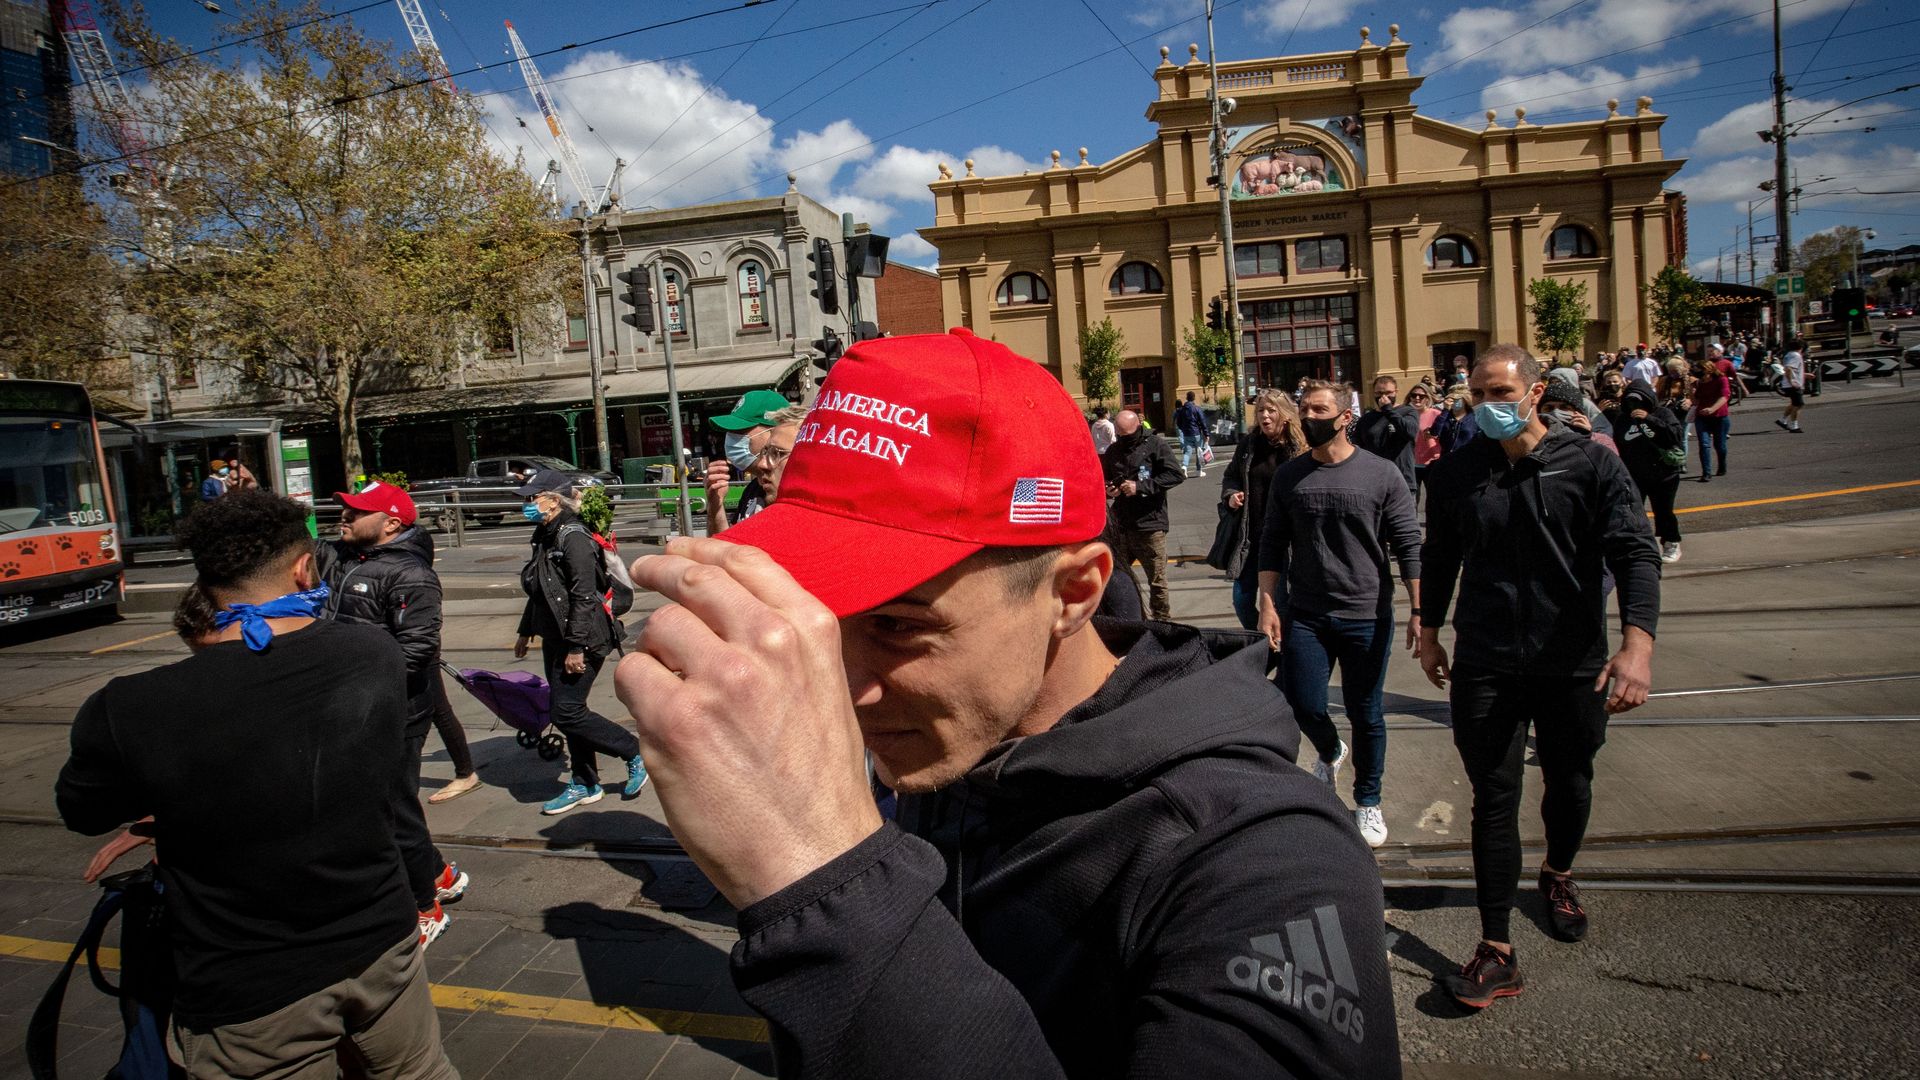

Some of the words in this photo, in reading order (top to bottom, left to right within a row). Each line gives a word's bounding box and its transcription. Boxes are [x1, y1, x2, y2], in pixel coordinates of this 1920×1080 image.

[1233, 220, 1260, 229] QUEEN
[1265, 215, 1308, 226] VICTORIA
[1312, 211, 1348, 221] MARKET
[666, 284, 679, 323] CHEMIST
[747, 276, 760, 314] CHEMIST
[818, 390, 931, 437] AMERICA
[819, 424, 911, 466] AGAIN
[69, 509, 104, 525] 5003
[0, 607, 29, 622] ogs
[1226, 955, 1364, 1044] adidas
